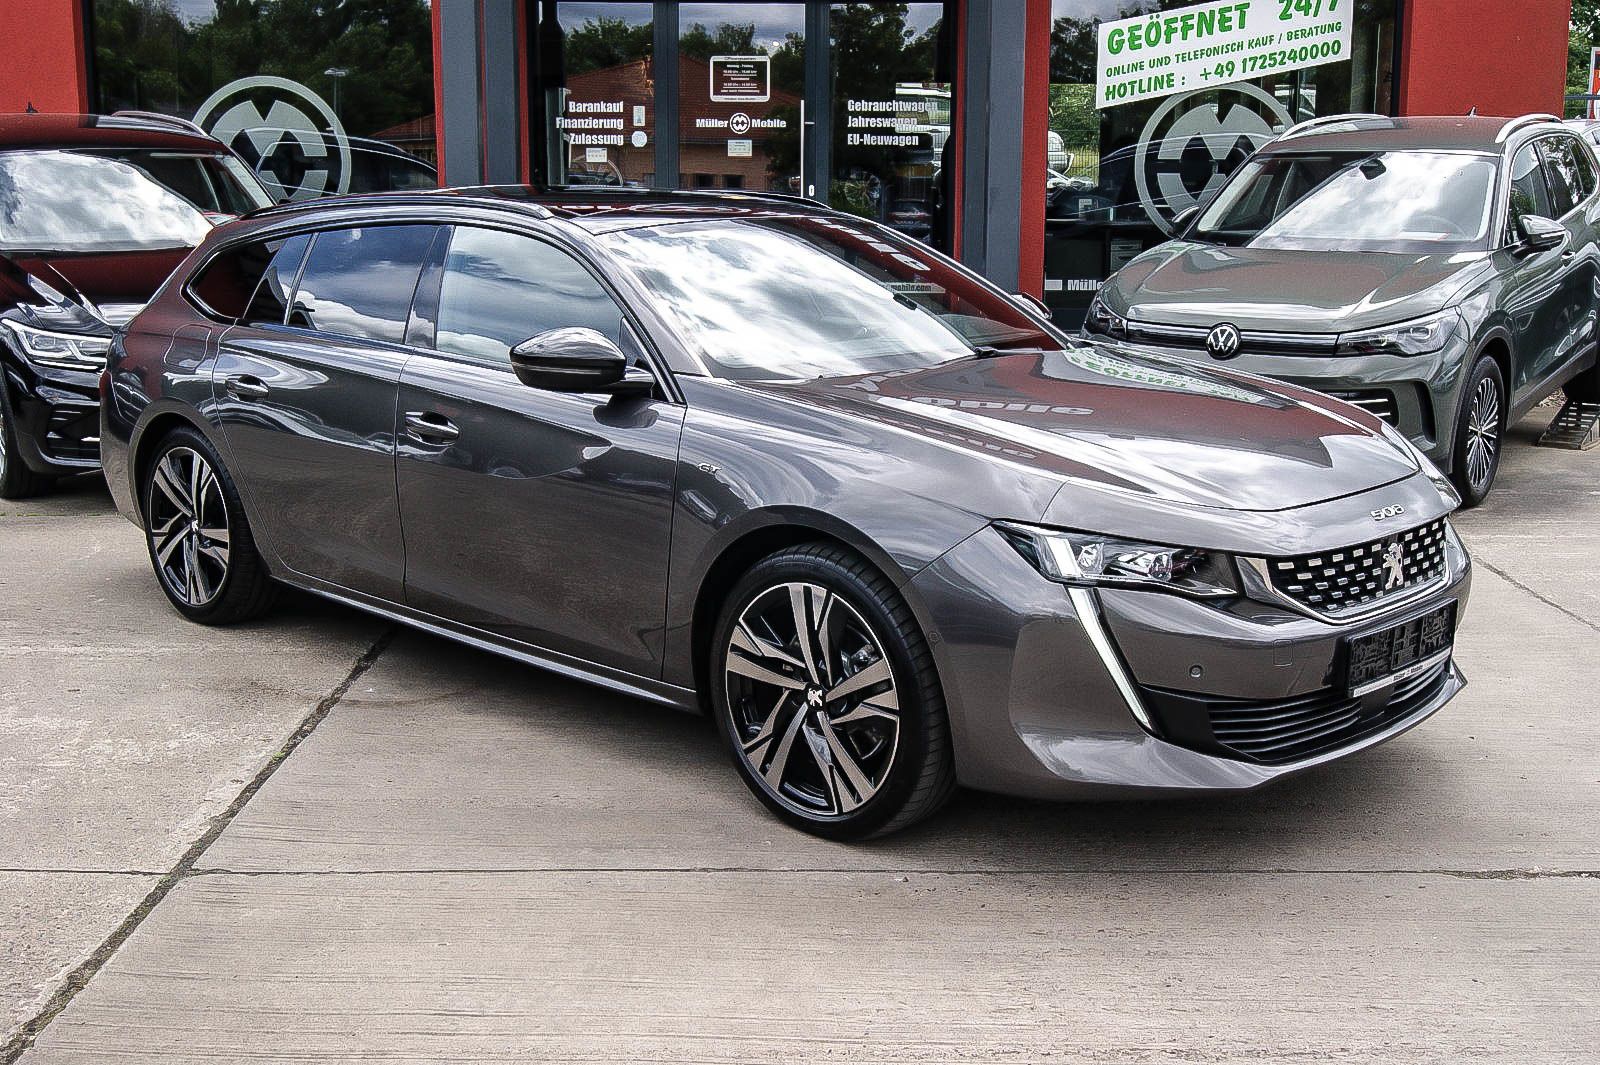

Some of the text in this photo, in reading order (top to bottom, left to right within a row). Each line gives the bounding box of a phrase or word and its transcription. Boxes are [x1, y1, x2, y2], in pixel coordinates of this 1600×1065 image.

[1108, 2, 1250, 54] GEÖFFNET
[1106, 61, 1144, 77] ONLINE
[1149, 56, 1171, 68] UND
[1175, 41, 1244, 63] TELEFONISCH
[1248, 35, 1274, 49] KAUF
[1287, 22, 1342, 41] BERATUNG
[1105, 73, 1175, 101] HOTLINE
[1200, 61, 1235, 80] +49
[1242, 40, 1341, 73] 1725240000
[569, 101, 624, 113] Barankauf
[848, 99, 938, 112] Gebrauchtwagen
[556, 117, 624, 130] Finanzierung
[696, 118, 787, 128] Müller Mobile
[848, 116, 918, 128] Jahreswagen
[570, 133, 624, 146] Zulassung
[848, 133, 919, 146] EU-Neuwagen
[1370, 504, 1404, 521] 508
